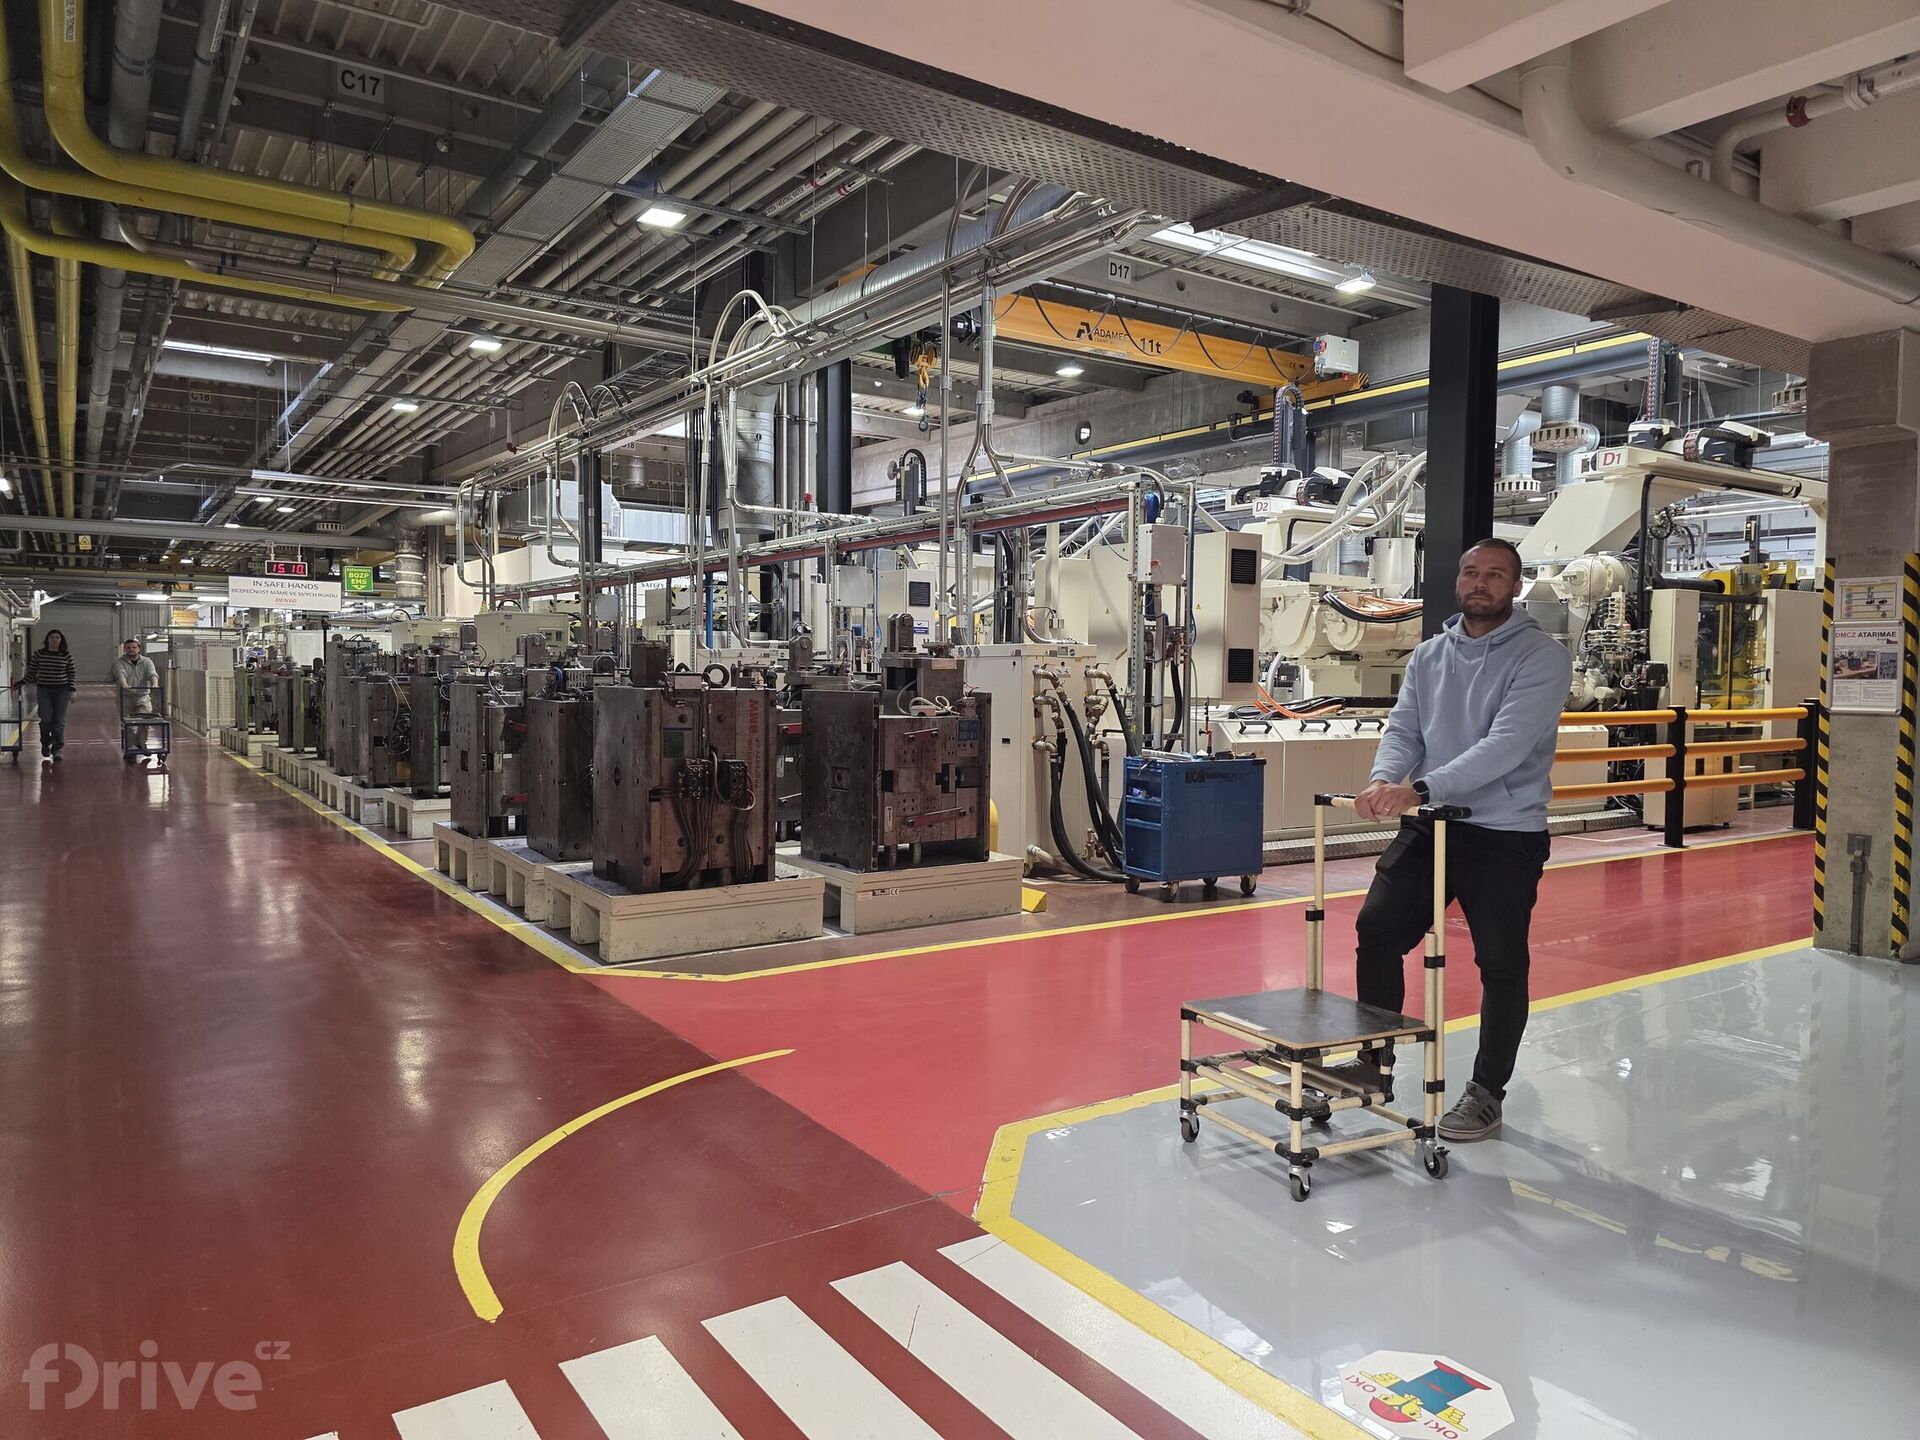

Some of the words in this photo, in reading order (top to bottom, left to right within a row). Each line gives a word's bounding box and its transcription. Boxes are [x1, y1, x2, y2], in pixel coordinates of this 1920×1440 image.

[340, 68, 382, 97] C17
[1109, 262, 1129, 279] D17
[1140, 337, 1162, 354] 11t
[1602, 452, 1622, 466] D1
[1255, 501, 1269, 513] D2
[264, 581, 286, 589] SAFE
[1835, 631, 1857, 639] DMCZ
[748, 698, 759, 734] BMW
